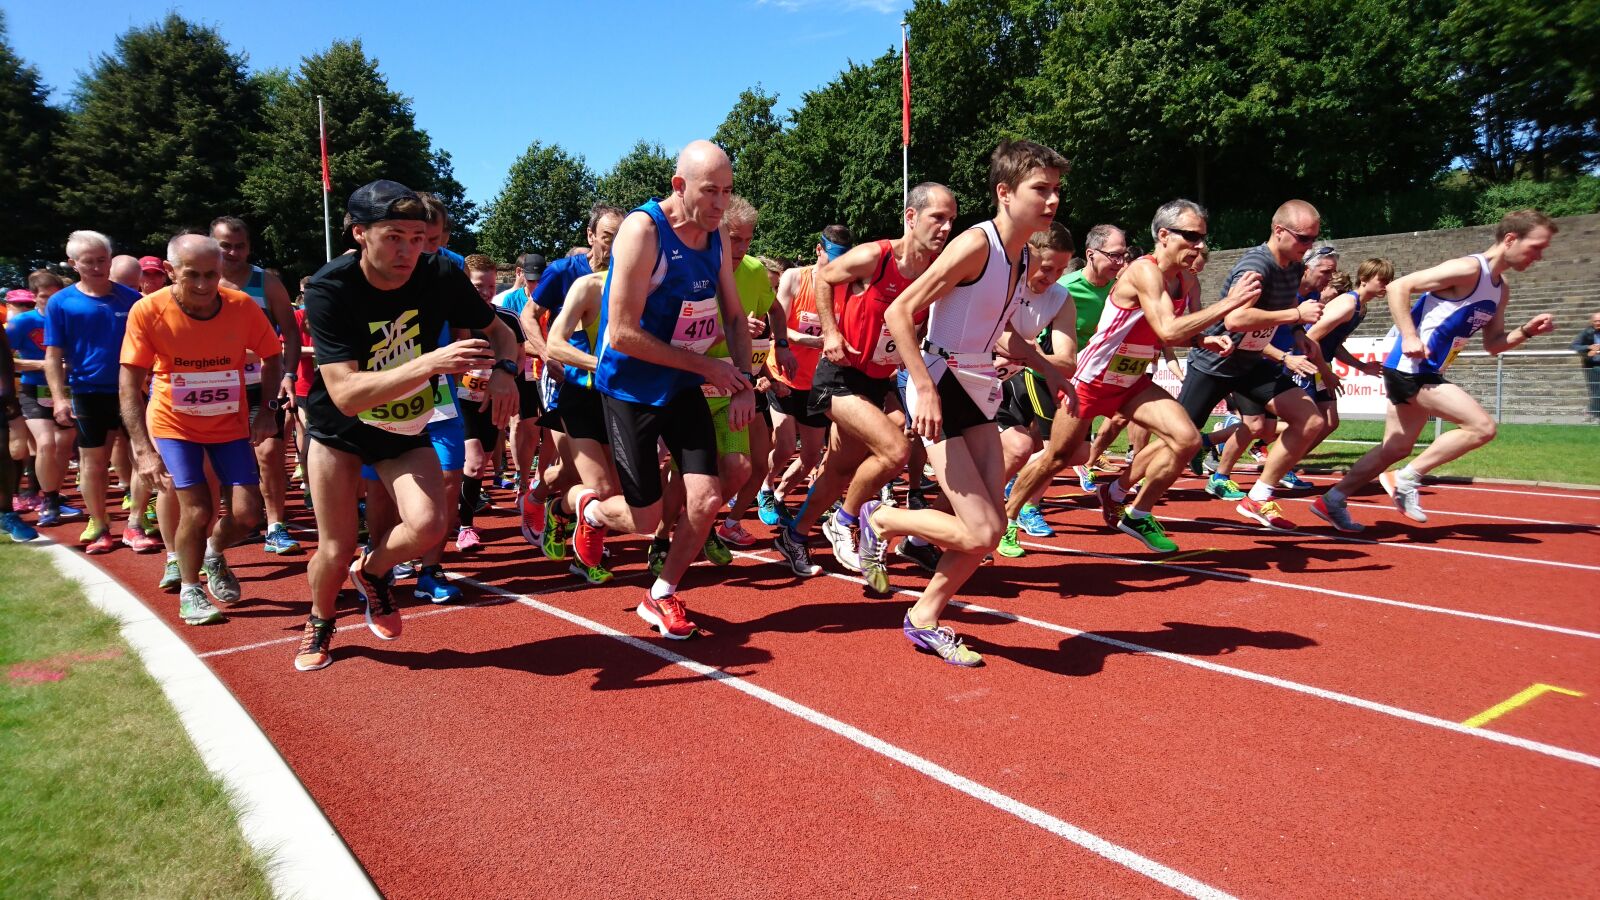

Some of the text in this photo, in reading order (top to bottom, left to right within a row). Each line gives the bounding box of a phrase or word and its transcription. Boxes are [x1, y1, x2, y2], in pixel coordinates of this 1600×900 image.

[684, 318, 715, 338] 470
[804, 325, 823, 337] 47
[174, 355, 232, 369] Bergheide
[751, 352, 766, 363] 02
[1335, 352, 1390, 377] STA
[1116, 357, 1147, 374] 541
[468, 377, 489, 392] 56
[1340, 383, 1386, 396] 0km-L
[183, 388, 230, 404] 455
[371, 396, 424, 420] 509
